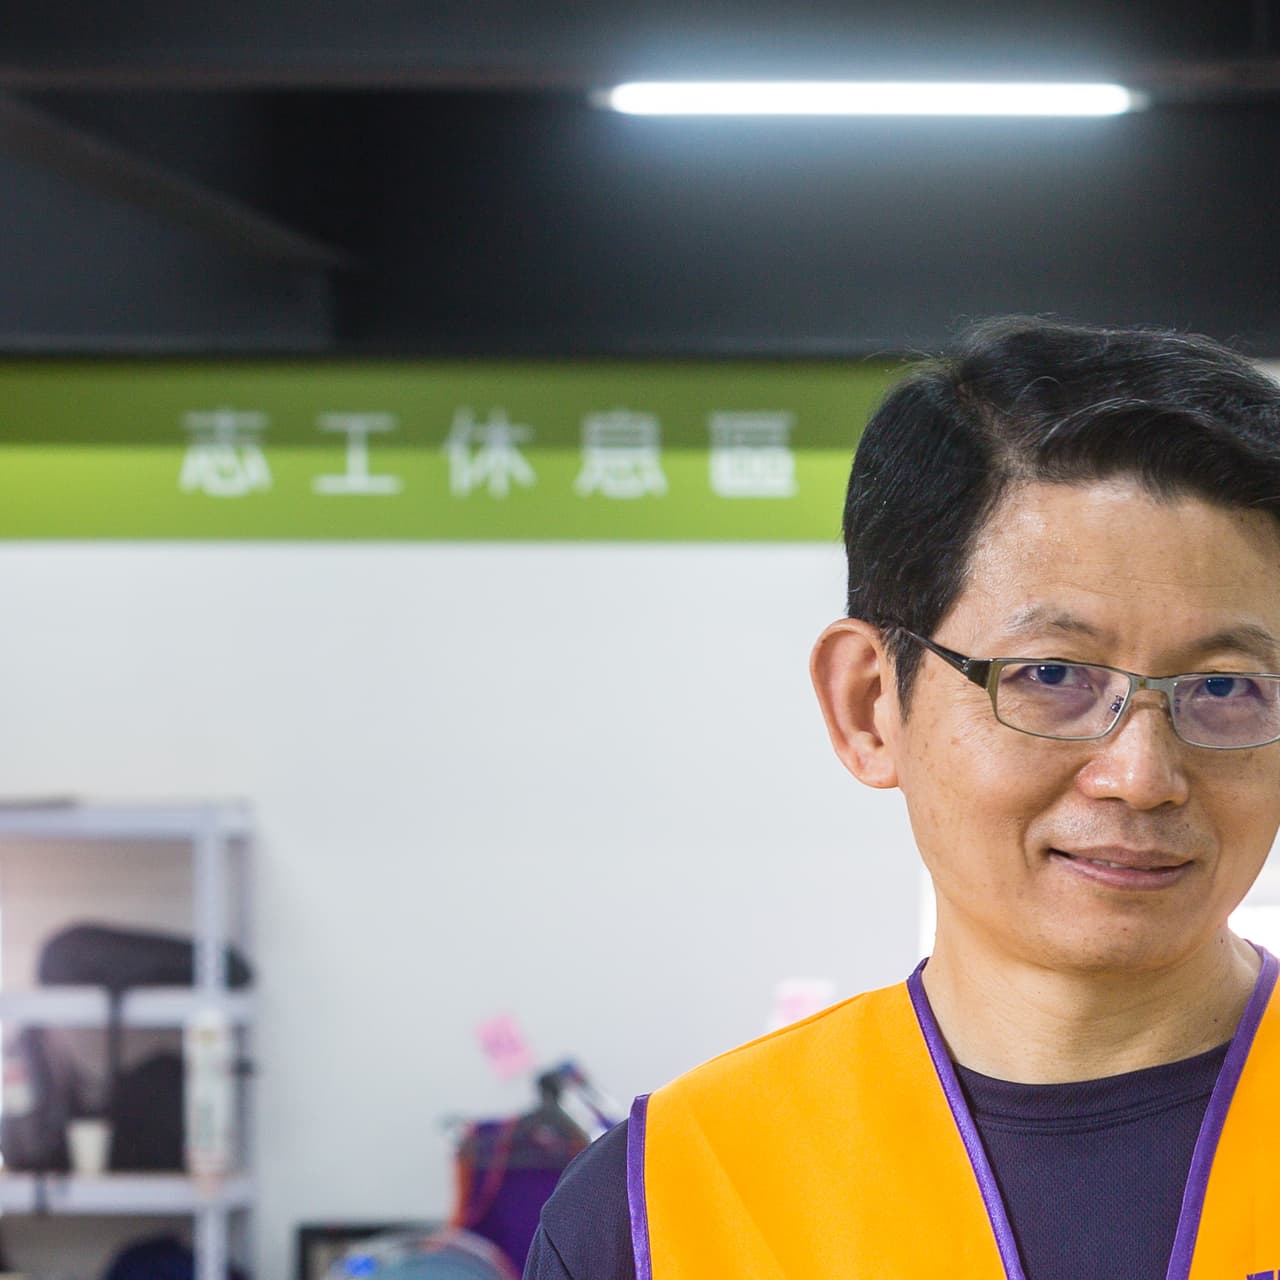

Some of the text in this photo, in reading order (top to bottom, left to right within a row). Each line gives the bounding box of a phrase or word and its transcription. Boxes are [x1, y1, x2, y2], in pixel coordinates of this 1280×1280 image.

[178, 407, 798, 500] 志工休息區
